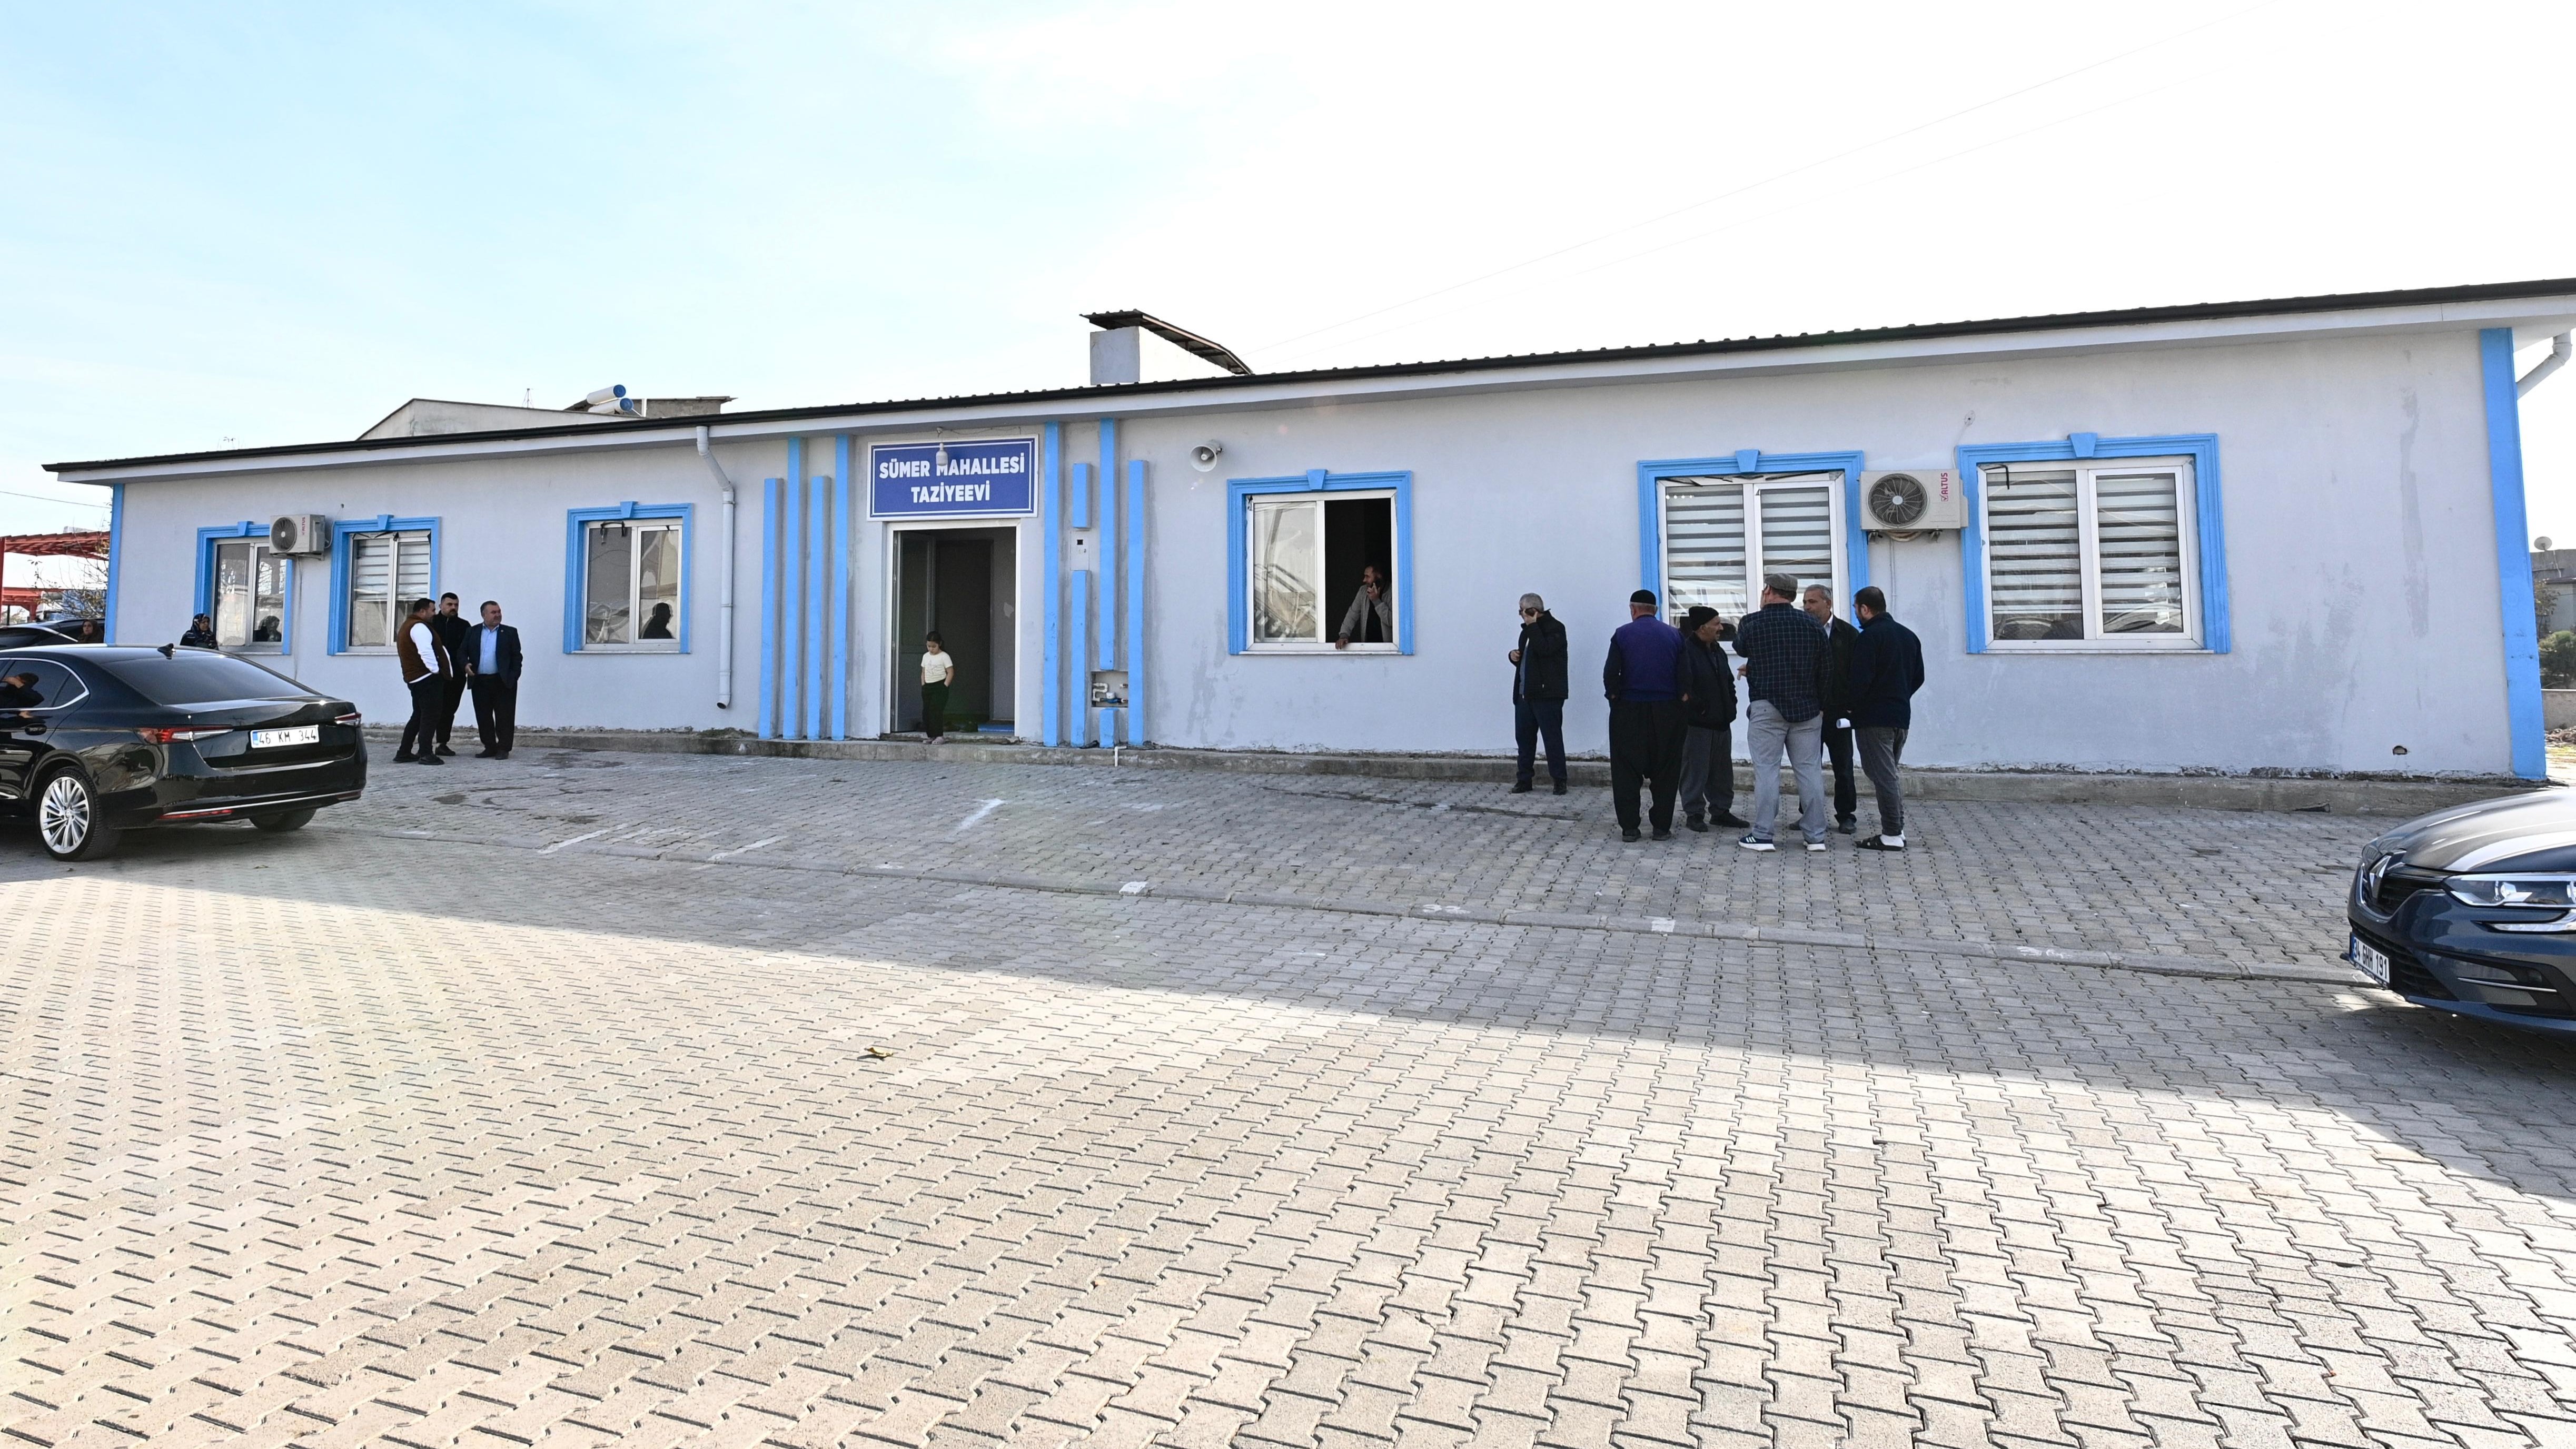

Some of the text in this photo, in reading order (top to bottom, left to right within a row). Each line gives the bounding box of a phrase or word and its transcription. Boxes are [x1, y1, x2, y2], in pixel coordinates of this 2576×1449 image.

[879, 452, 1025, 479] SÜMER MAHALLESİ
[911, 480, 990, 503] TAZİYEEVİ
[260, 729, 316, 744] 46 KM 344
[2354, 939, 2360, 961] 34
[2376, 954, 2387, 979] 191
